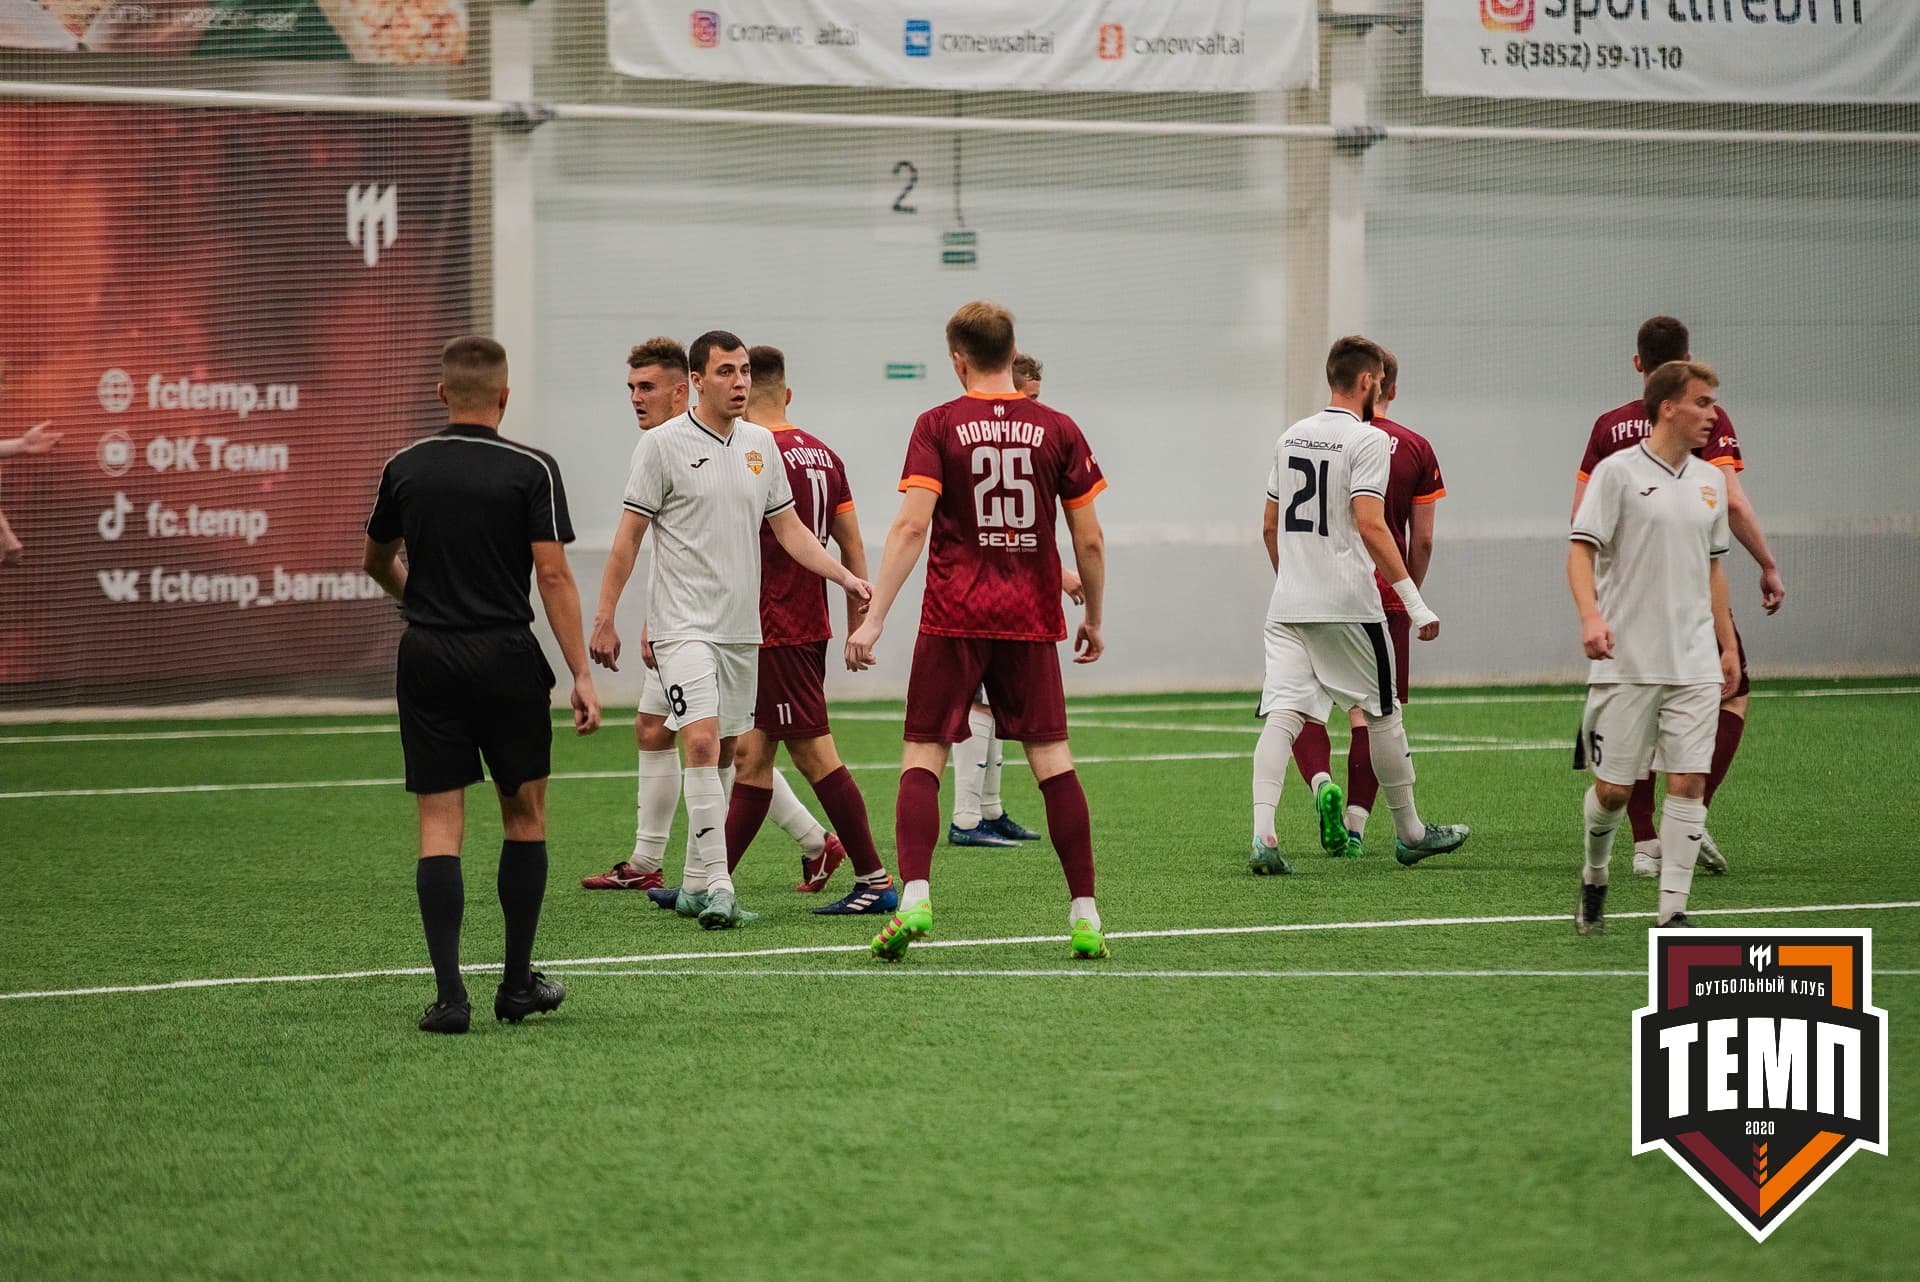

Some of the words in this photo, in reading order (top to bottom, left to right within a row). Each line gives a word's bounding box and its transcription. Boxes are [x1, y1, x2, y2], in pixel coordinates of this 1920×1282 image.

[1506, 41, 1590, 72] 8(3852)
[1596, 44, 1682, 70] 59-11-10
[893, 160, 918, 213] 2
[147, 374, 299, 417] fctemp.ru
[146, 436, 199, 471] ФК
[205, 437, 289, 471] Темп
[955, 420, 1045, 448] НОВИЧКОВ
[805, 468, 828, 544] 11
[971, 446, 1036, 529] 25
[1285, 455, 1329, 537] 21
[147, 501, 268, 545] fc.temp
[978, 532, 1038, 547] SEUS
[776, 702, 793, 725] 11
